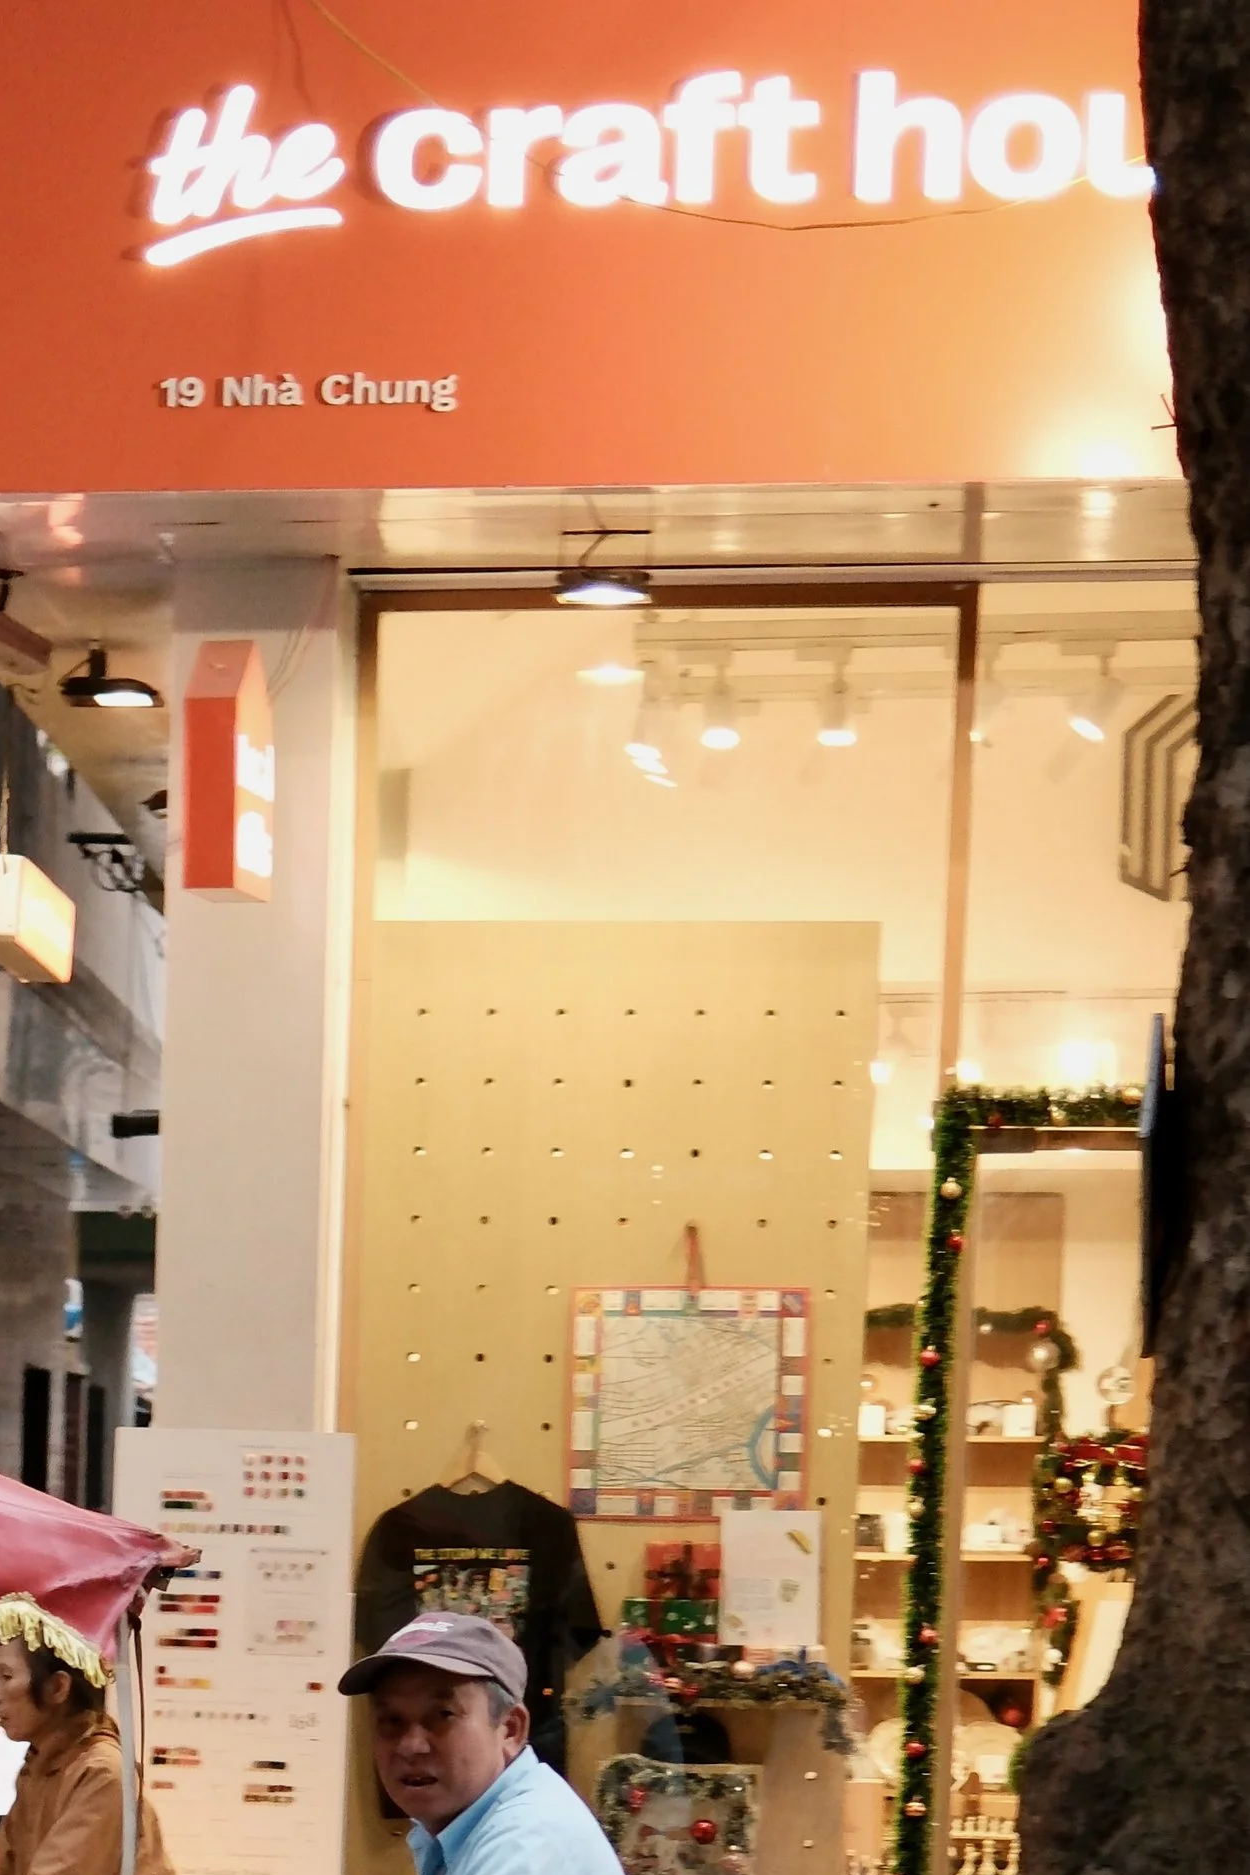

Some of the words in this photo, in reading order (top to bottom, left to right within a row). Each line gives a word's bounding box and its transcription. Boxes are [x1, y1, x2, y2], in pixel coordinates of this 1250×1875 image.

[149, 84, 345, 225] the
[376, 70, 820, 210] craft
[160, 376, 205, 407] 19
[222, 373, 303, 407] Nhà
[320, 372, 458, 412] Chung
